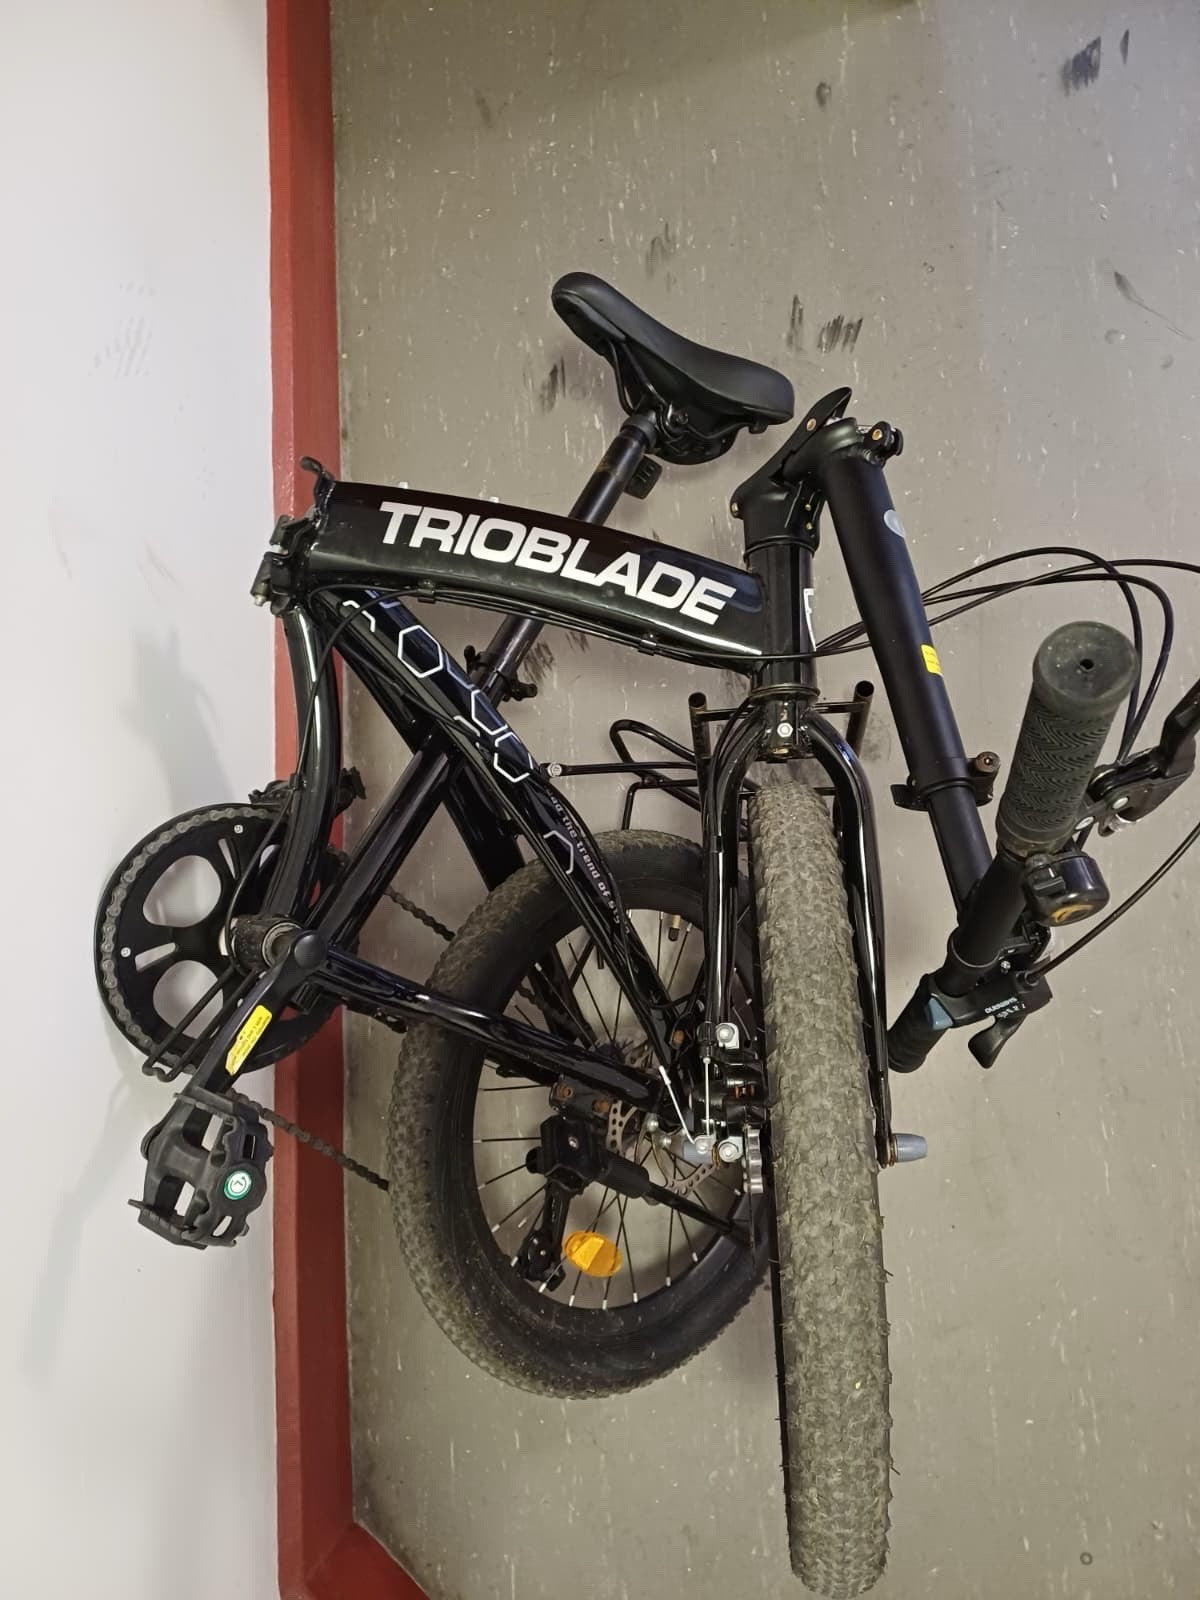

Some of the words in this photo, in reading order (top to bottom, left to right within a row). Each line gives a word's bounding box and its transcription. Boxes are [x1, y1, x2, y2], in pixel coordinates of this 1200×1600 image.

[380, 501, 736, 625] TRIOBLADE
[563, 815, 578, 838] the
[577, 841, 600, 879] trend
[598, 881, 611, 897] of
